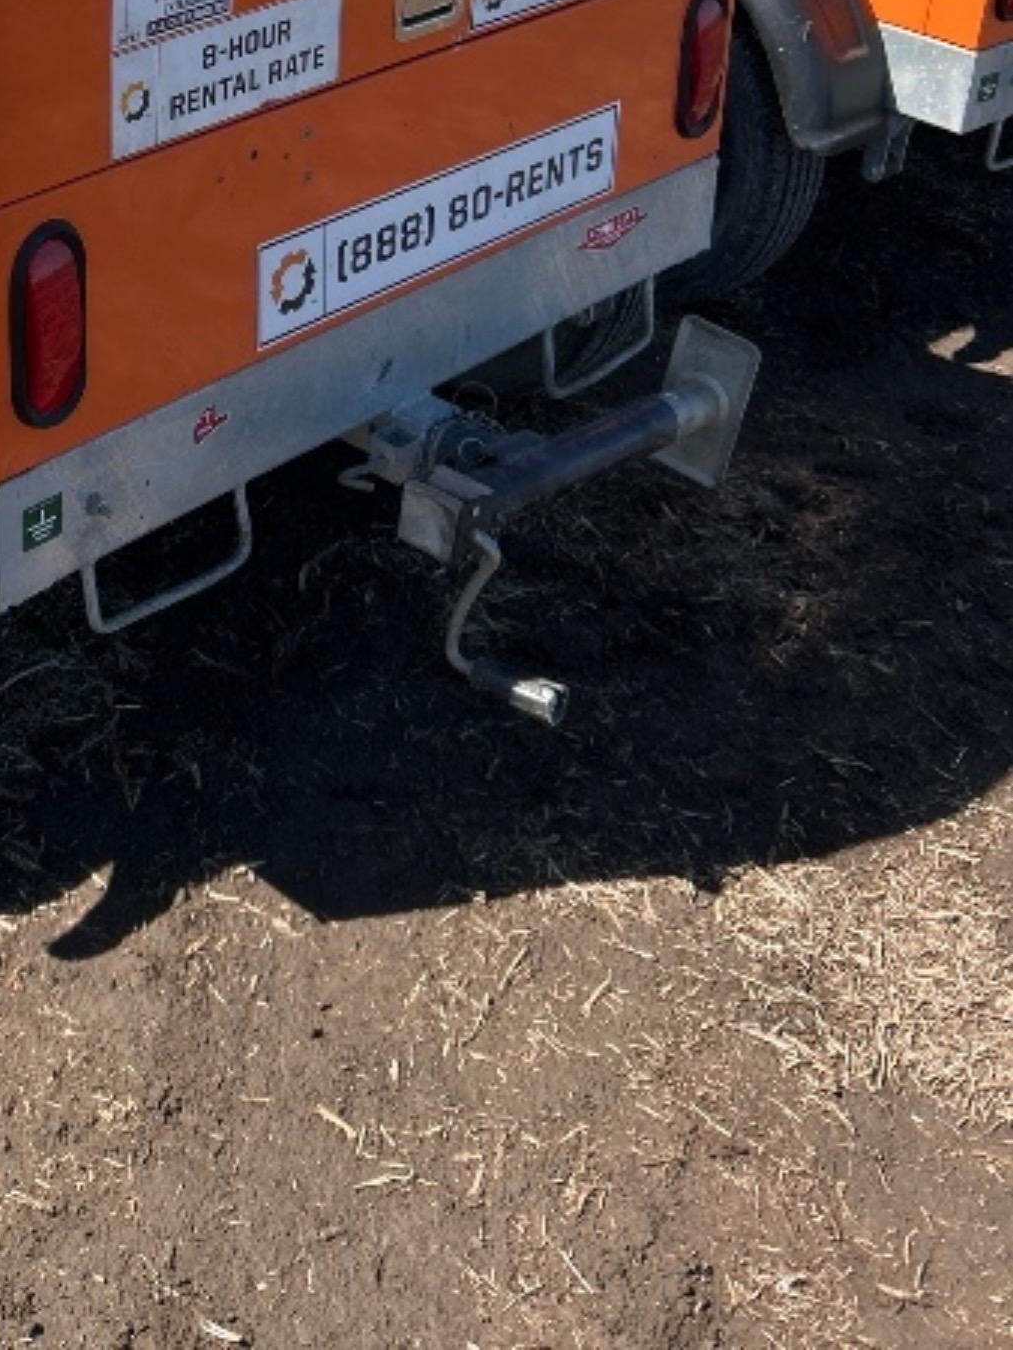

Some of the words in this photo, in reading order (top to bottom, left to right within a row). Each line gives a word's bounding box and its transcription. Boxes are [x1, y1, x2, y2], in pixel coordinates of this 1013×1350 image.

[169, 68, 261, 121] RENTAL
[267, 44, 325, 84] RATE
[201, 19, 292, 70] 8-HOUR
[337, 202, 436, 283] (888)
[448, 137, 604, 231] 80-RENTS
